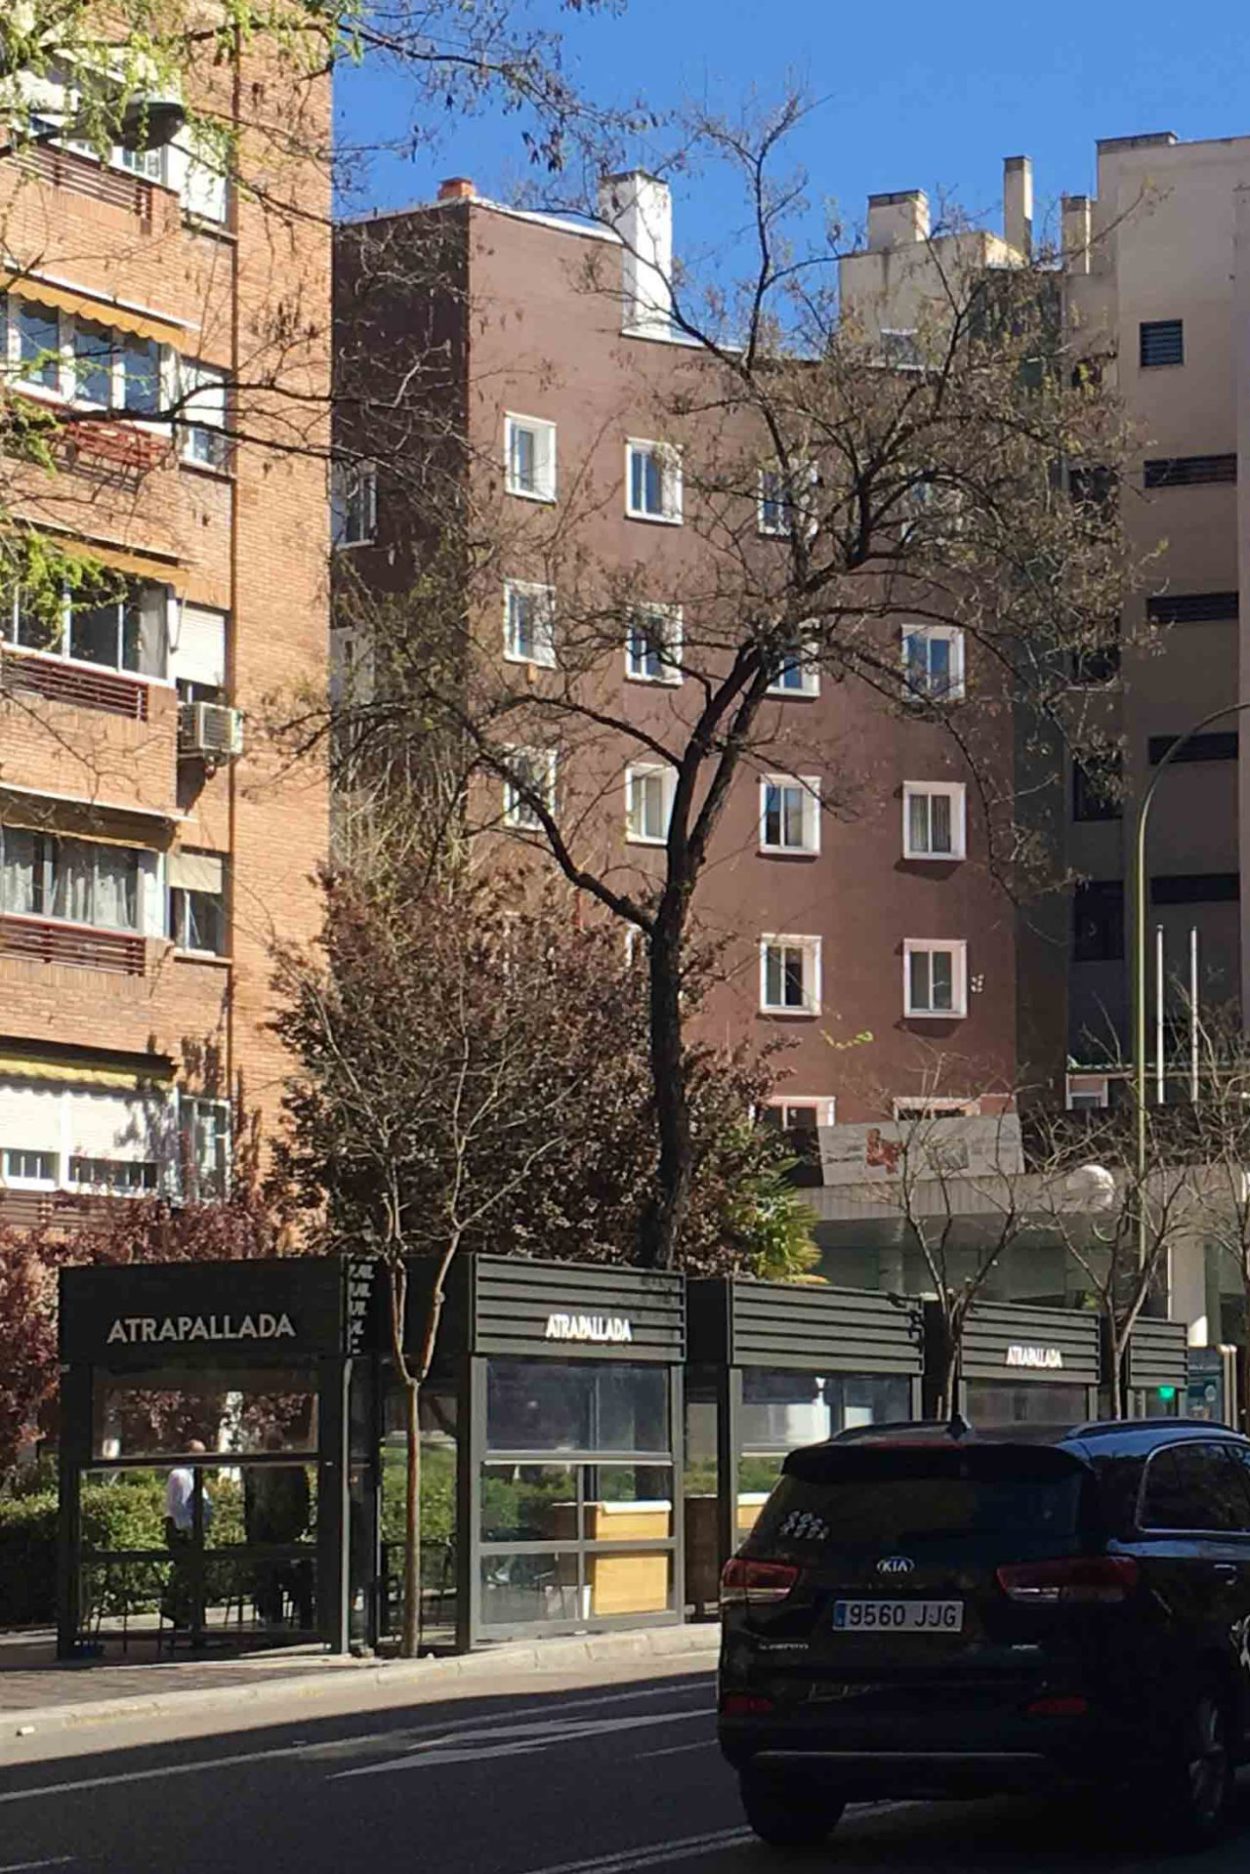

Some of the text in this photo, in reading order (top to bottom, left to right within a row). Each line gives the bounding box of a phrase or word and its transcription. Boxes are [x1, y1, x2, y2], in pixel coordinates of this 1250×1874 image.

[106, 1312, 296, 1345] ATRAPALLADA
[545, 1313, 633, 1341] ATRAPALLADA
[849, 1604, 956, 1627] 9560 JJG
